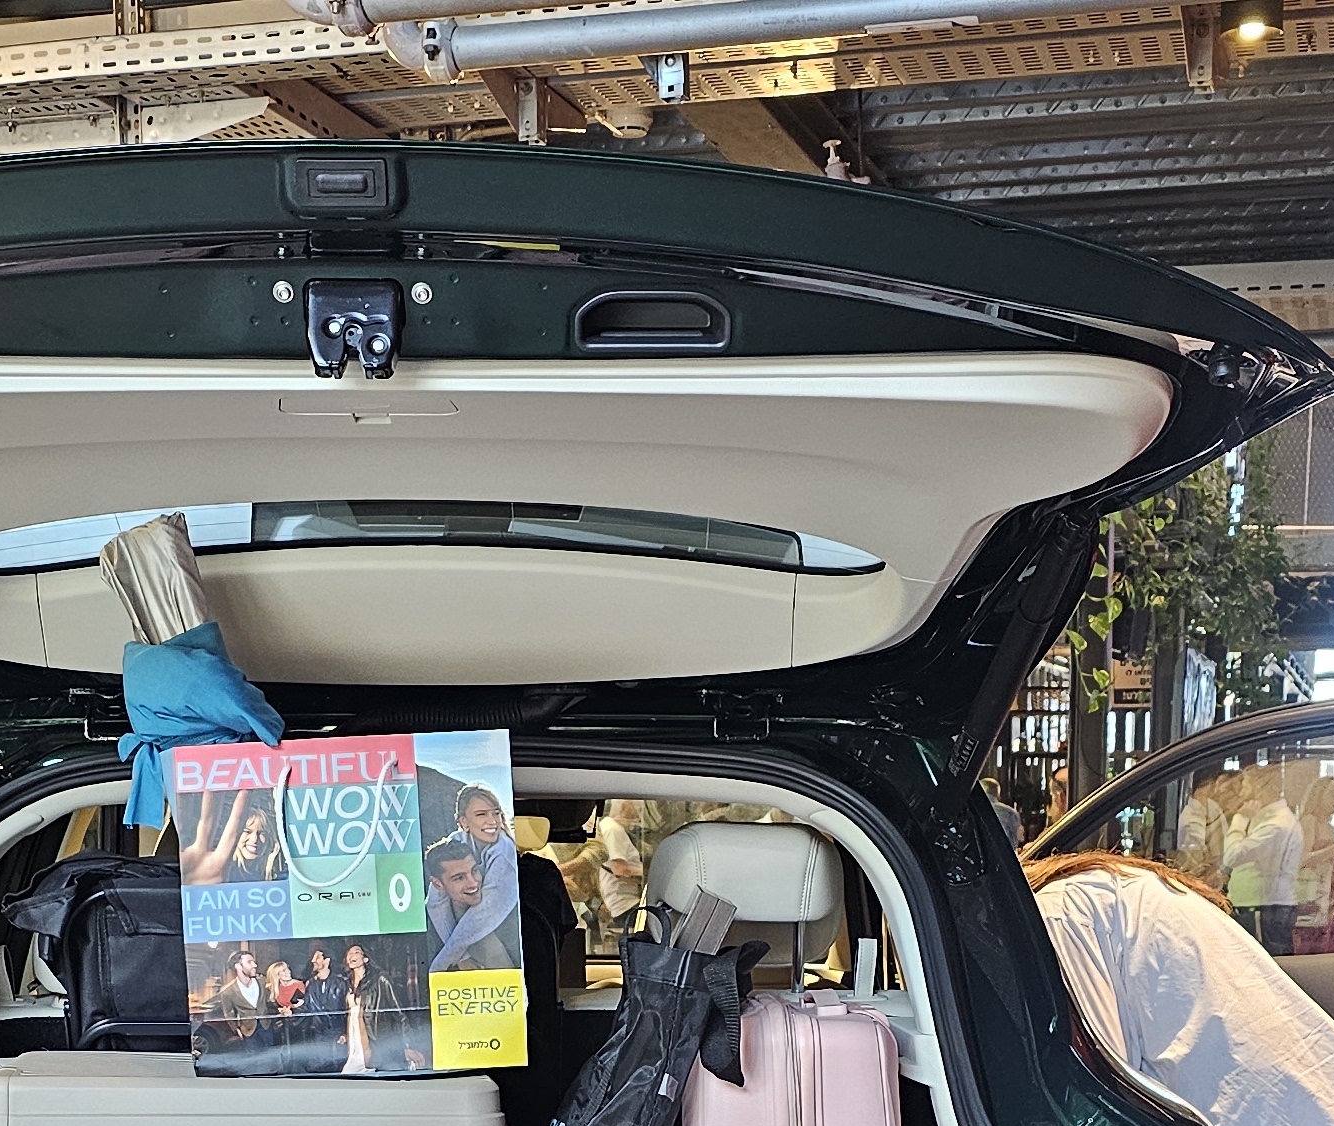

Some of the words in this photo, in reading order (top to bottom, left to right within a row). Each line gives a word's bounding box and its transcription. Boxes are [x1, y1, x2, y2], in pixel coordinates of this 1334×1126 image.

[176, 750, 415, 791] BEAUTIFUL
[287, 783, 415, 821] WOW
[288, 819, 417, 856] WOW
[185, 891, 192, 912] I
[197, 889, 240, 911] AM
[247, 887, 287, 908] SO
[297, 891, 355, 902] ORA
[187, 912, 288, 937] FUNKY
[436, 985, 519, 1002] POSITIVE
[437, 999, 519, 1017] ENERGY
